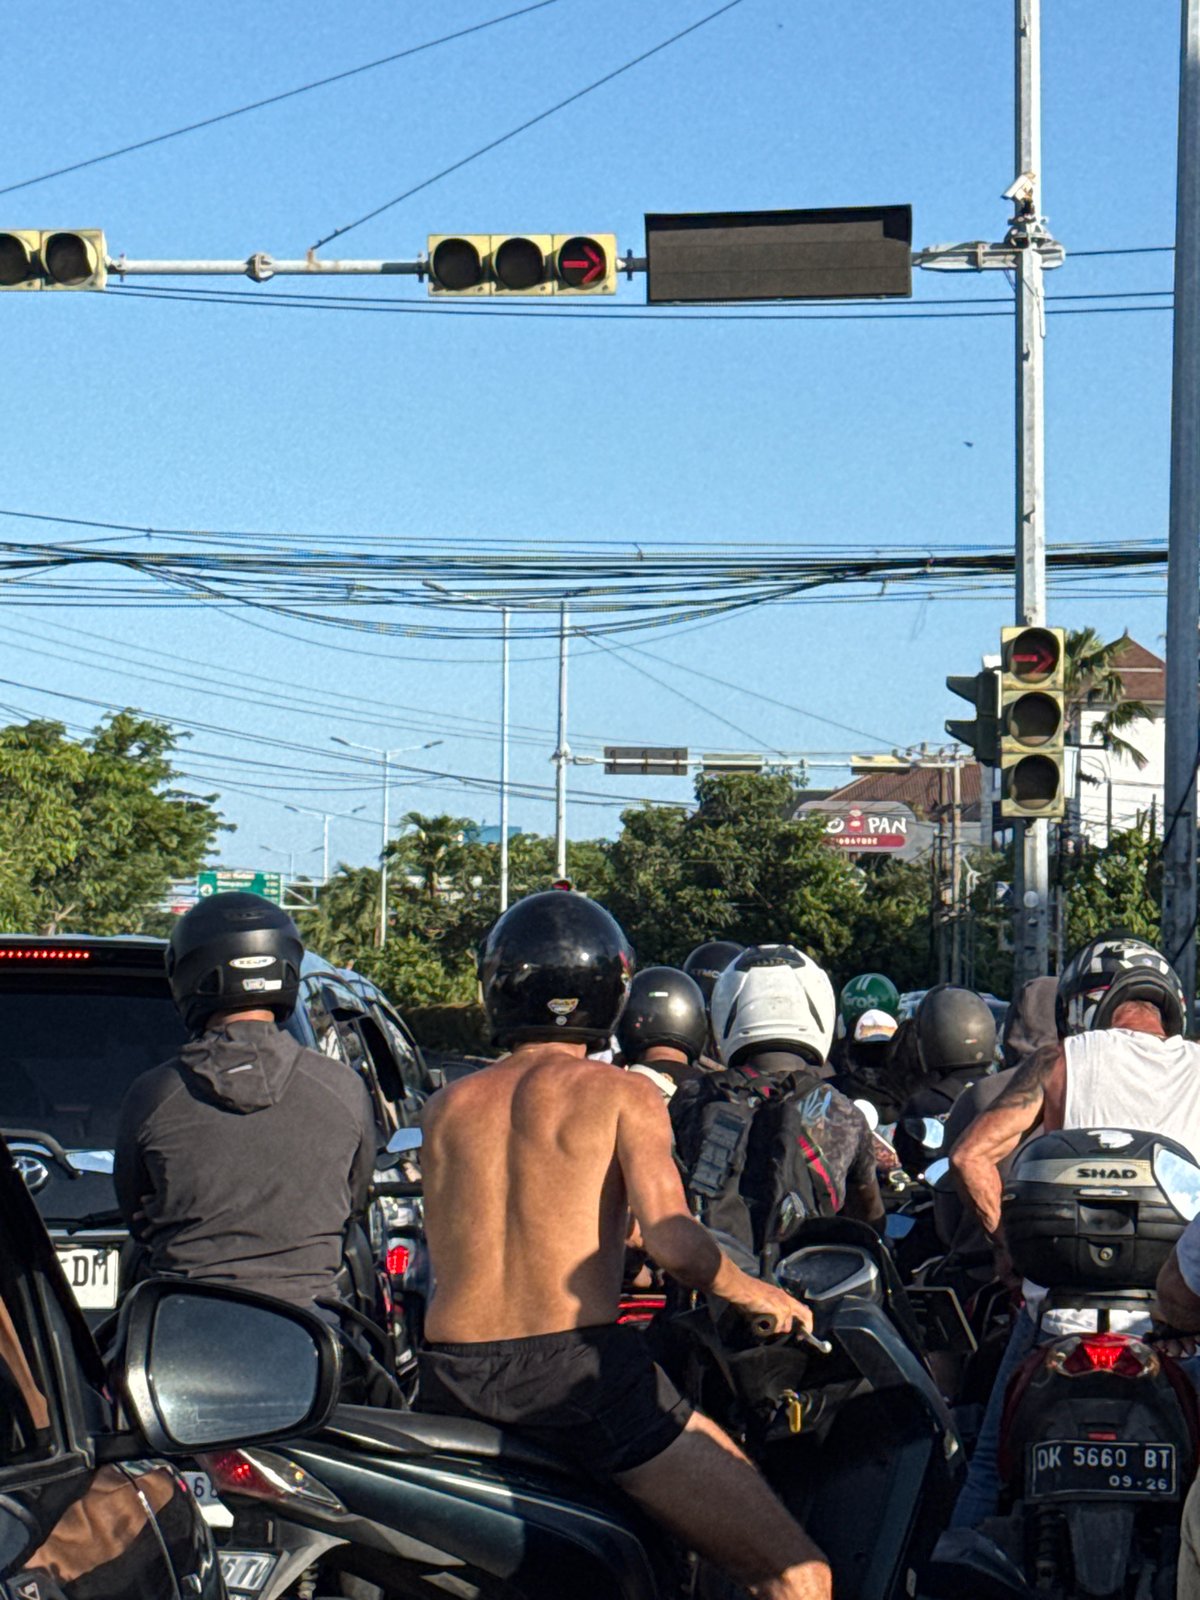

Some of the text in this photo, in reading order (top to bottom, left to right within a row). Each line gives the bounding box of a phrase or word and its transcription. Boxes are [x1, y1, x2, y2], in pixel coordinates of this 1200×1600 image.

[867, 816, 907, 834] PAN
[843, 991, 880, 1009] Grab
[1076, 1167, 1138, 1179] SHAD
[1037, 1446, 1171, 1471] DK 5660 BT
